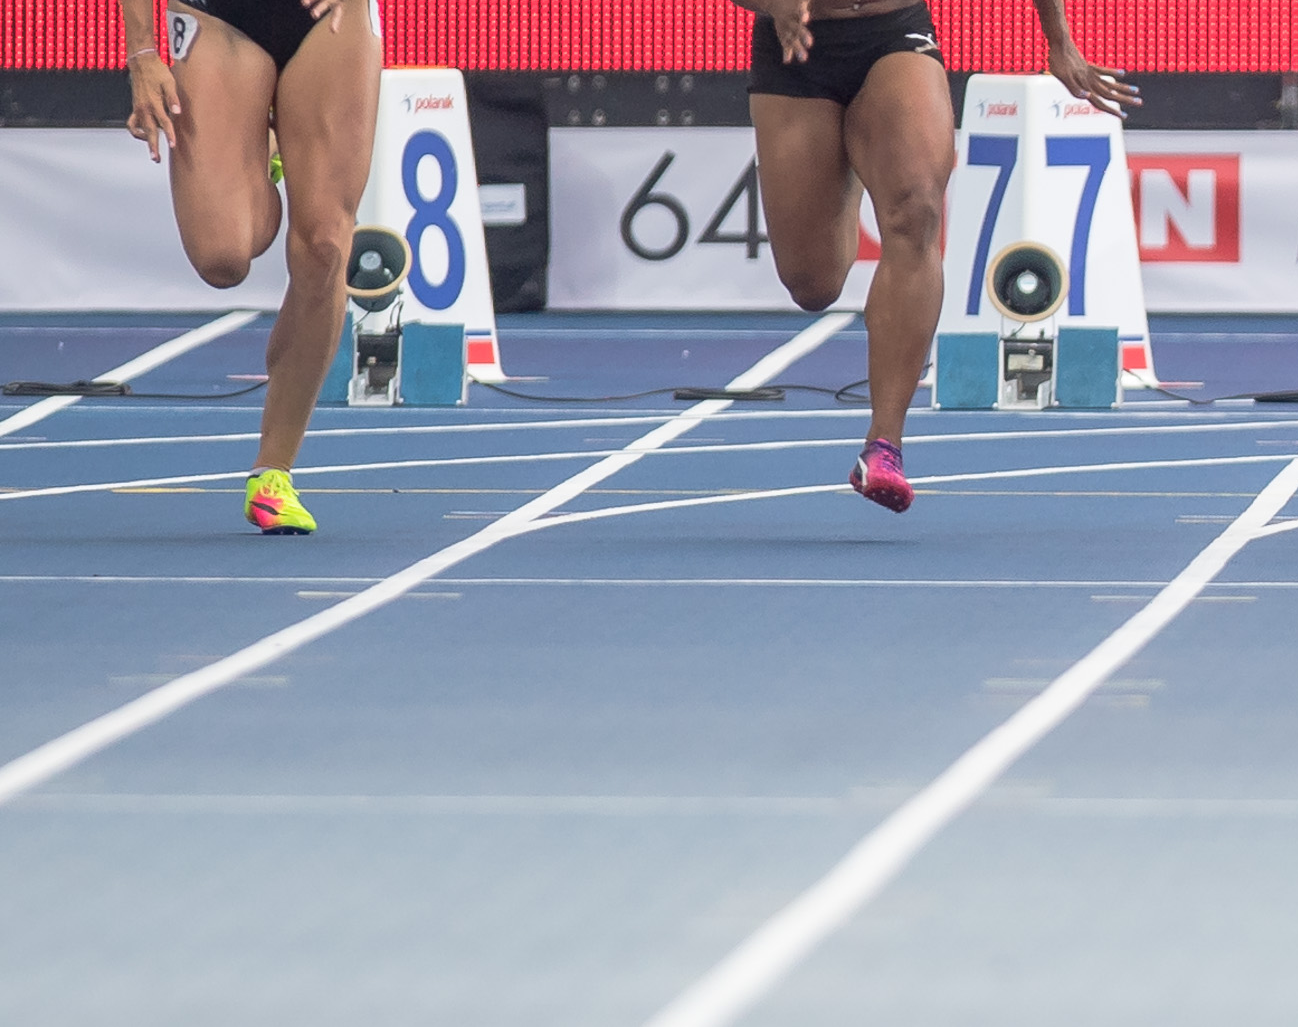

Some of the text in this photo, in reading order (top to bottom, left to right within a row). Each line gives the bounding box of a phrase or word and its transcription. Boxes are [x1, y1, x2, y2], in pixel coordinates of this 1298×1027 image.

[173, 16, 186, 54] 8
[415, 94, 454, 114] polanik
[402, 128, 466, 310] 8
[966, 134, 1019, 316] 7
[1045, 134, 1111, 316] 7
